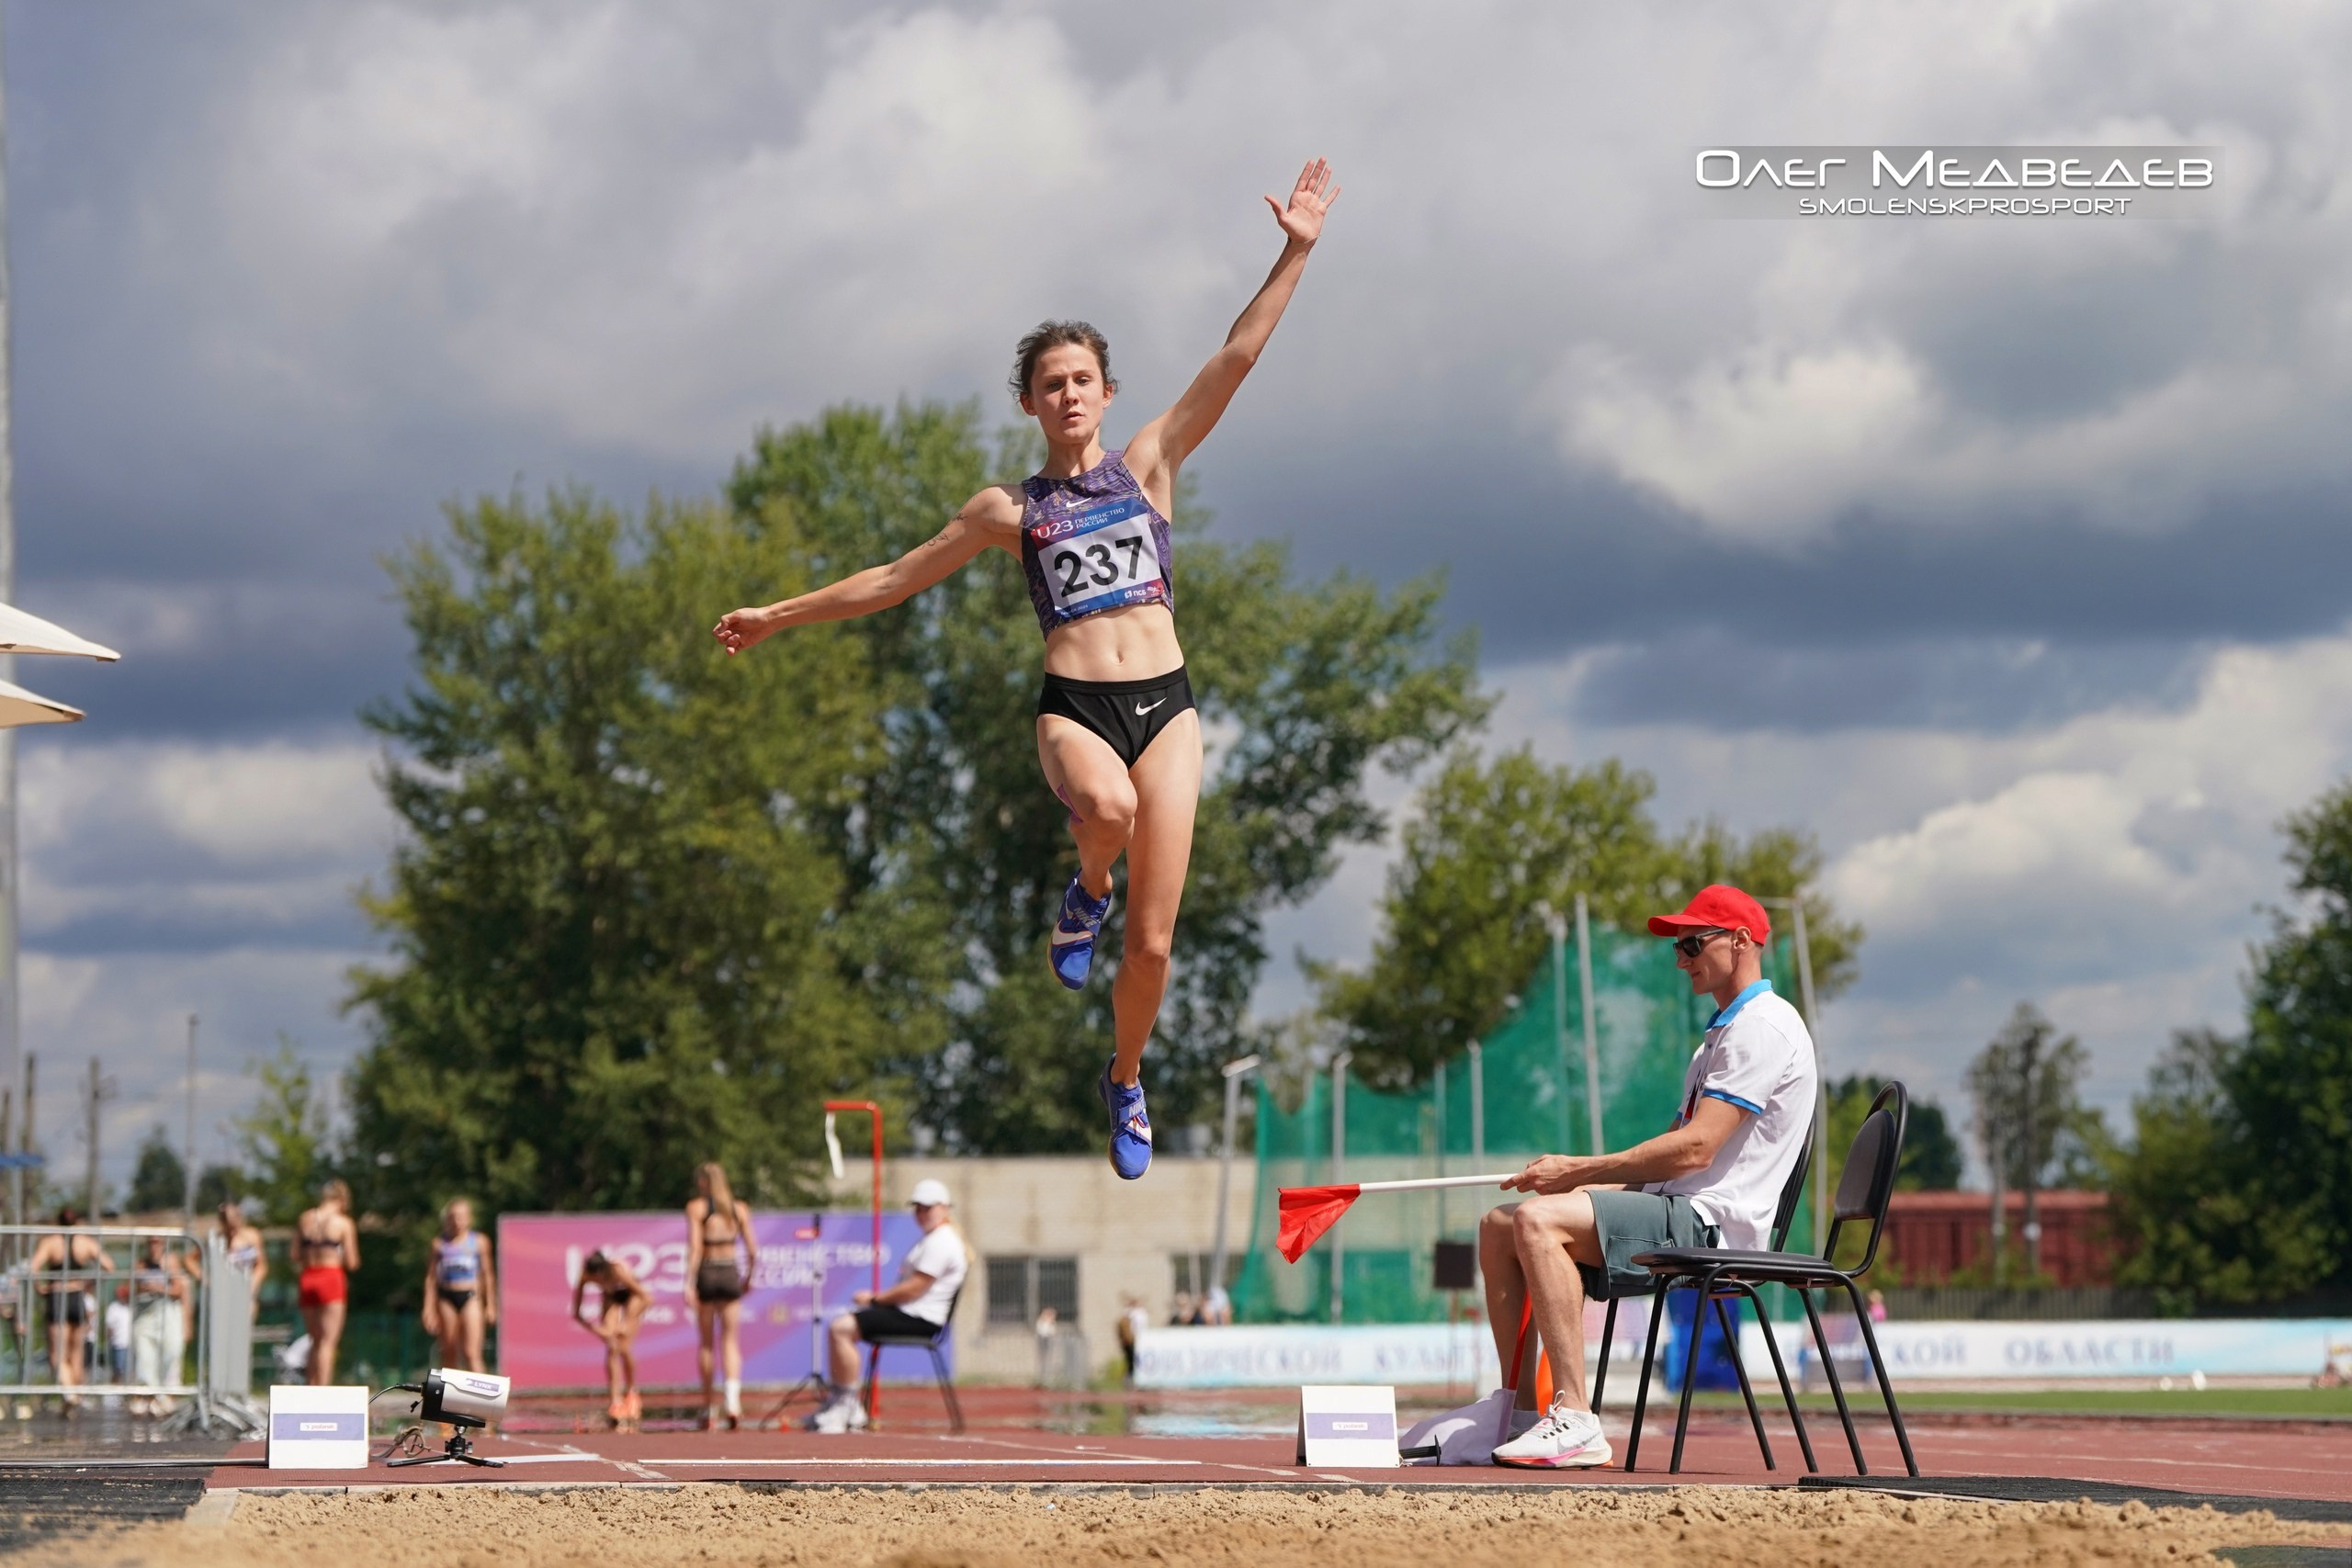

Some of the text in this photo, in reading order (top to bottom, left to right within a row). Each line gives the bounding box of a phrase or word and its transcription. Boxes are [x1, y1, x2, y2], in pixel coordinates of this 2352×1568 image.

[1074, 507, 1125, 525] ПЕРВЕНСТВО
[1076, 517, 1108, 529] РОССИИ
[1036, 520, 1074, 539] U23
[1054, 535, 1143, 598] 237
[1074, 907, 1097, 927] NIKE
[474, 1381, 492, 1390] LYNX
